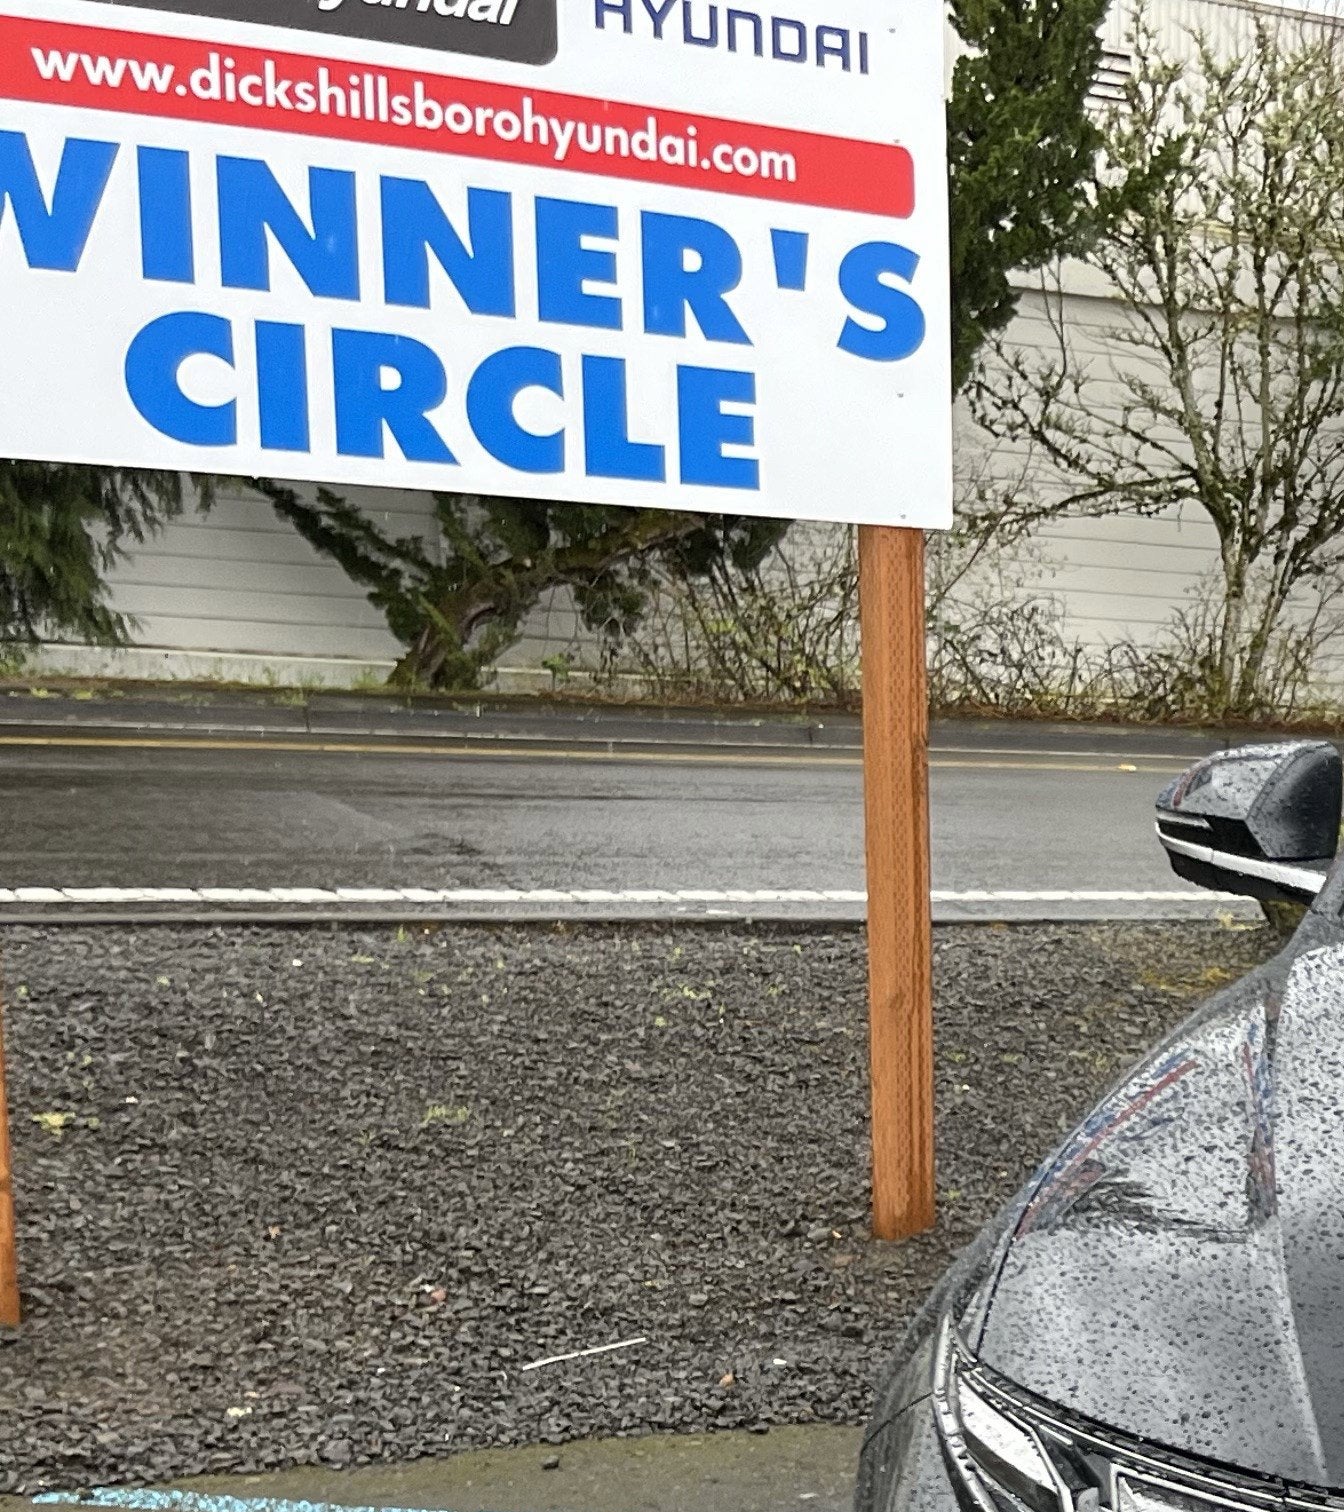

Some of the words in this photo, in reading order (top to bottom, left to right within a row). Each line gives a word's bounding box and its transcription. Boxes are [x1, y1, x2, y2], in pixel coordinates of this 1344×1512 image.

[31, 41, 797, 183] www.dickshillsborohyundai.com
[595, 0, 869, 75] HYUNDAI
[0, 129, 926, 362] WINNER'S
[125, 311, 760, 491] CIRCLE
